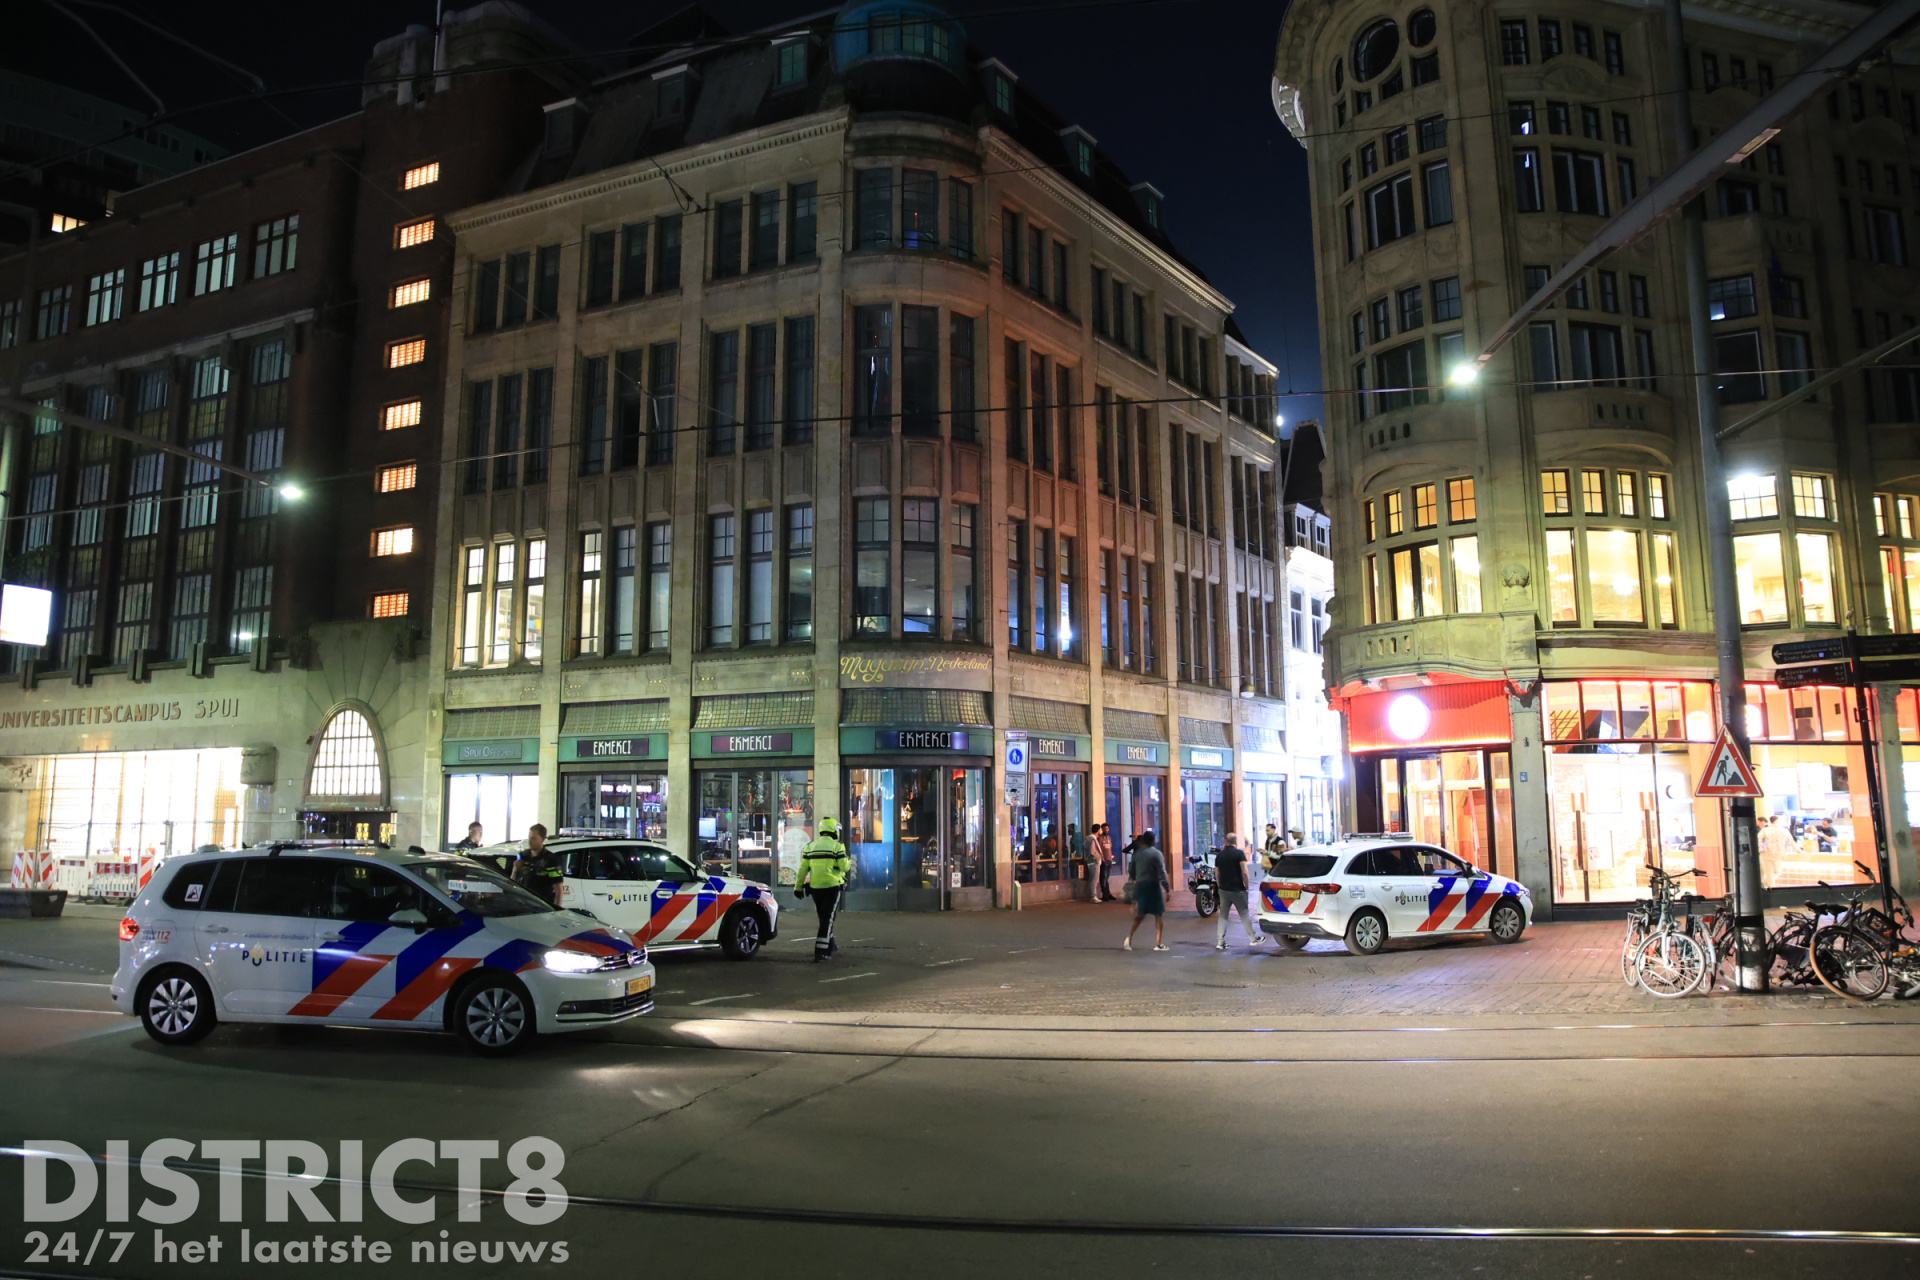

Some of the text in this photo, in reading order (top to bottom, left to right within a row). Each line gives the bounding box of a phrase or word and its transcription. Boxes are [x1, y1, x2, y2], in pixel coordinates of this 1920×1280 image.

[0, 698, 240, 729] UNIVERSITEITSCAMPUS SPUI
[593, 740, 632, 755] EKMEKCI
[730, 735, 772, 752] EKMEKCI
[899, 731, 952, 748] EKMEKCI
[1038, 739, 1066, 755] EKMEKCI
[1127, 746, 1149, 760] EKMEKCI
[1395, 893, 1427, 905] POLITIE
